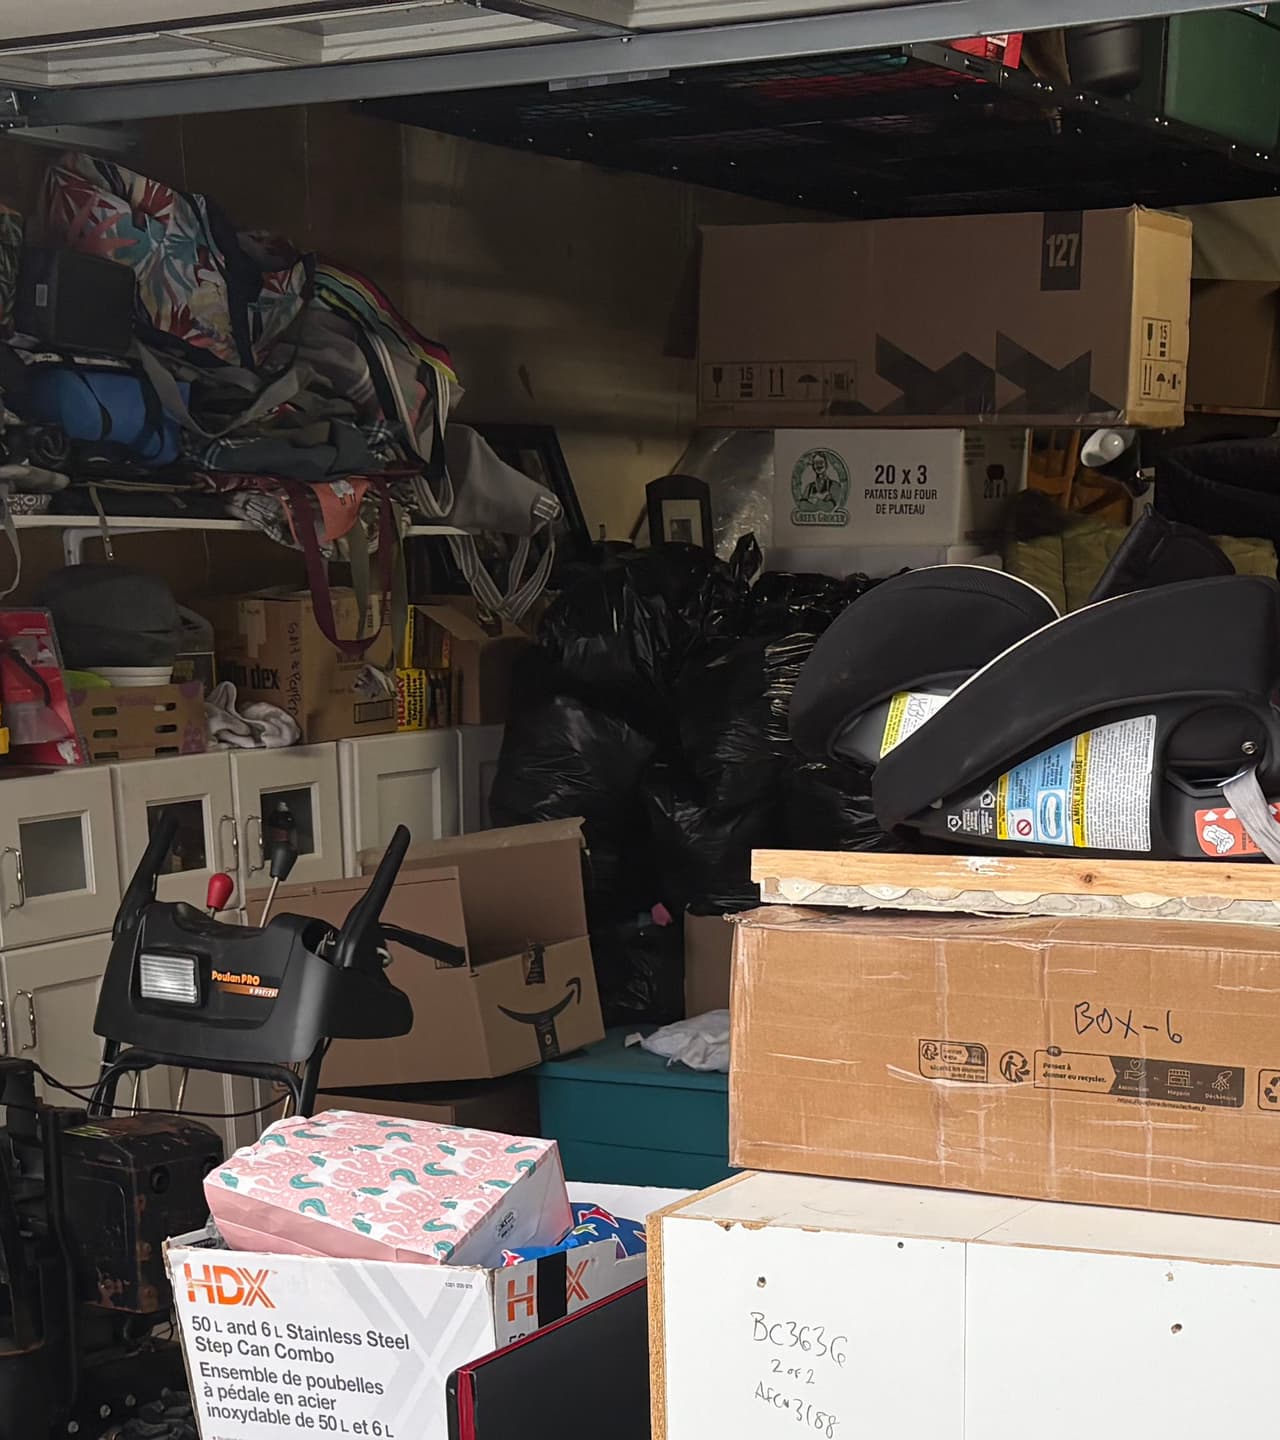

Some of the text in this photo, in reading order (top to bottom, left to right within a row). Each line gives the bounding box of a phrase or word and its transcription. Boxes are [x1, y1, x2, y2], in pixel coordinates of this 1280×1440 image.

[1046, 233, 1080, 268] 127
[875, 464, 927, 485] 20 x 3
[864, 488, 937, 500] PATATES AU FOUR
[876, 503, 925, 515] DE PLATEAU
[211, 969, 261, 986] Poulan PRO
[183, 1263, 276, 1309] HDX
[507, 1259, 590, 1322] HX
[192, 1316, 410, 1350] 50 L and 6 L Stainless Steel
[750, 1311, 848, 1368] BC3636
[195, 1336, 334, 1364] Step Can Combo
[199, 1362, 384, 1395] Ensemble de poubelles
[771, 1358, 783, 1373] 2
[806, 1368, 815, 1384] 2
[204, 1383, 336, 1410] à pédale en acier
[207, 1402, 394, 1438] inoxydable de 50 L et 6 L
